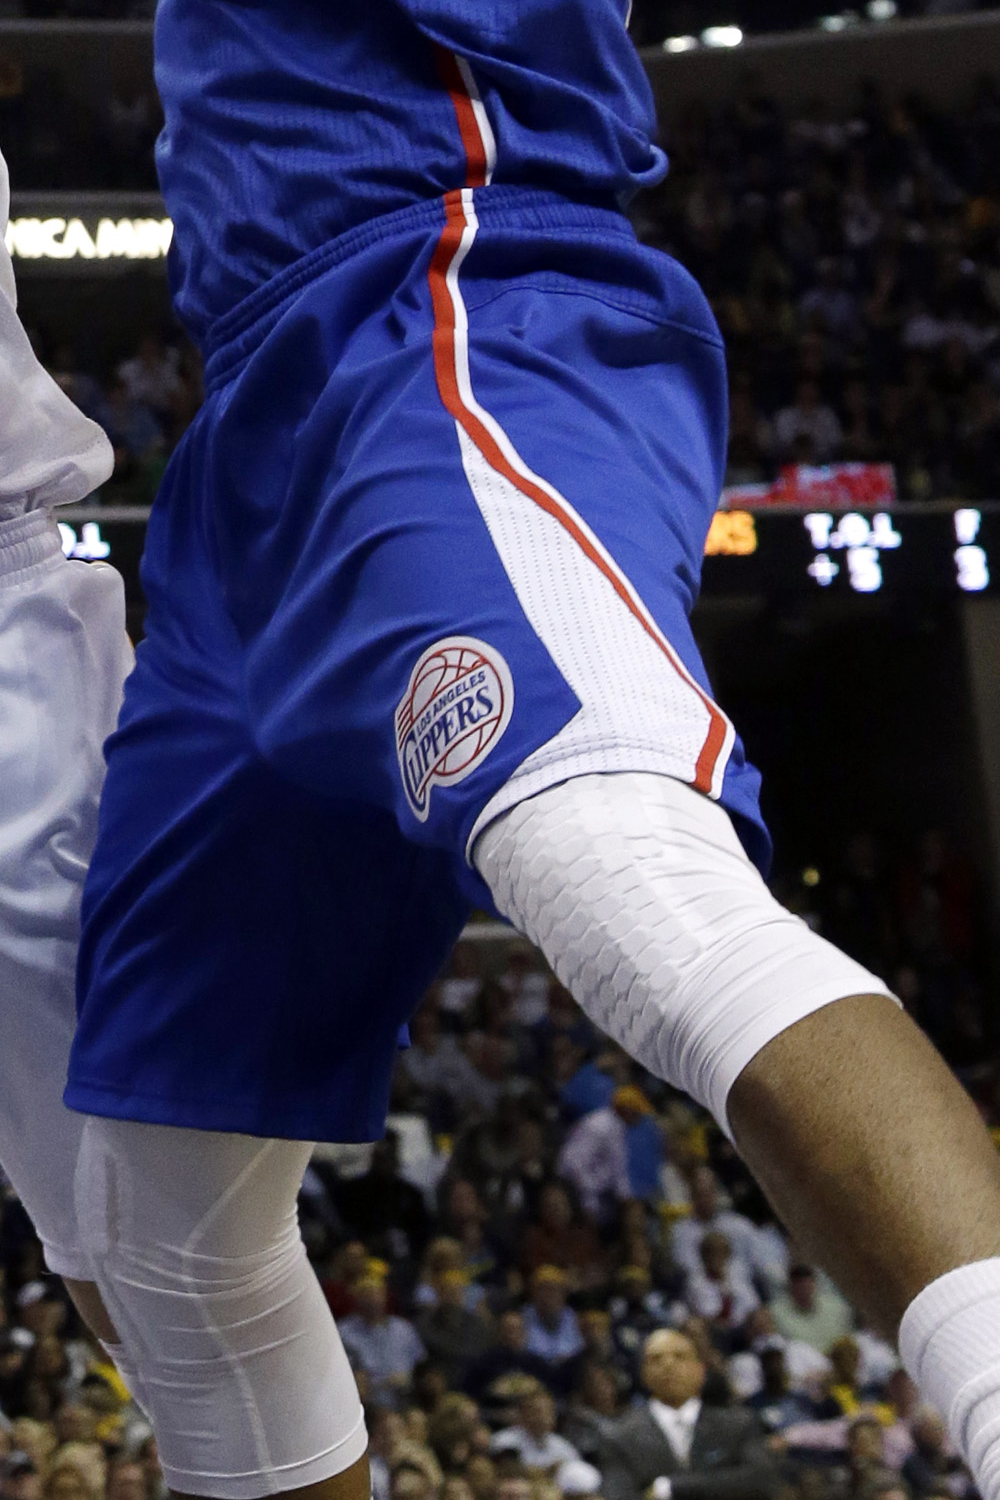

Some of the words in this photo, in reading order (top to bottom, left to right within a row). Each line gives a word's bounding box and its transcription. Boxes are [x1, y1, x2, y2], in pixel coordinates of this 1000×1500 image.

[403, 685, 494, 813] CLIPPERS
[416, 713, 433, 737] LOS
[433, 670, 486, 717] ANGELES
